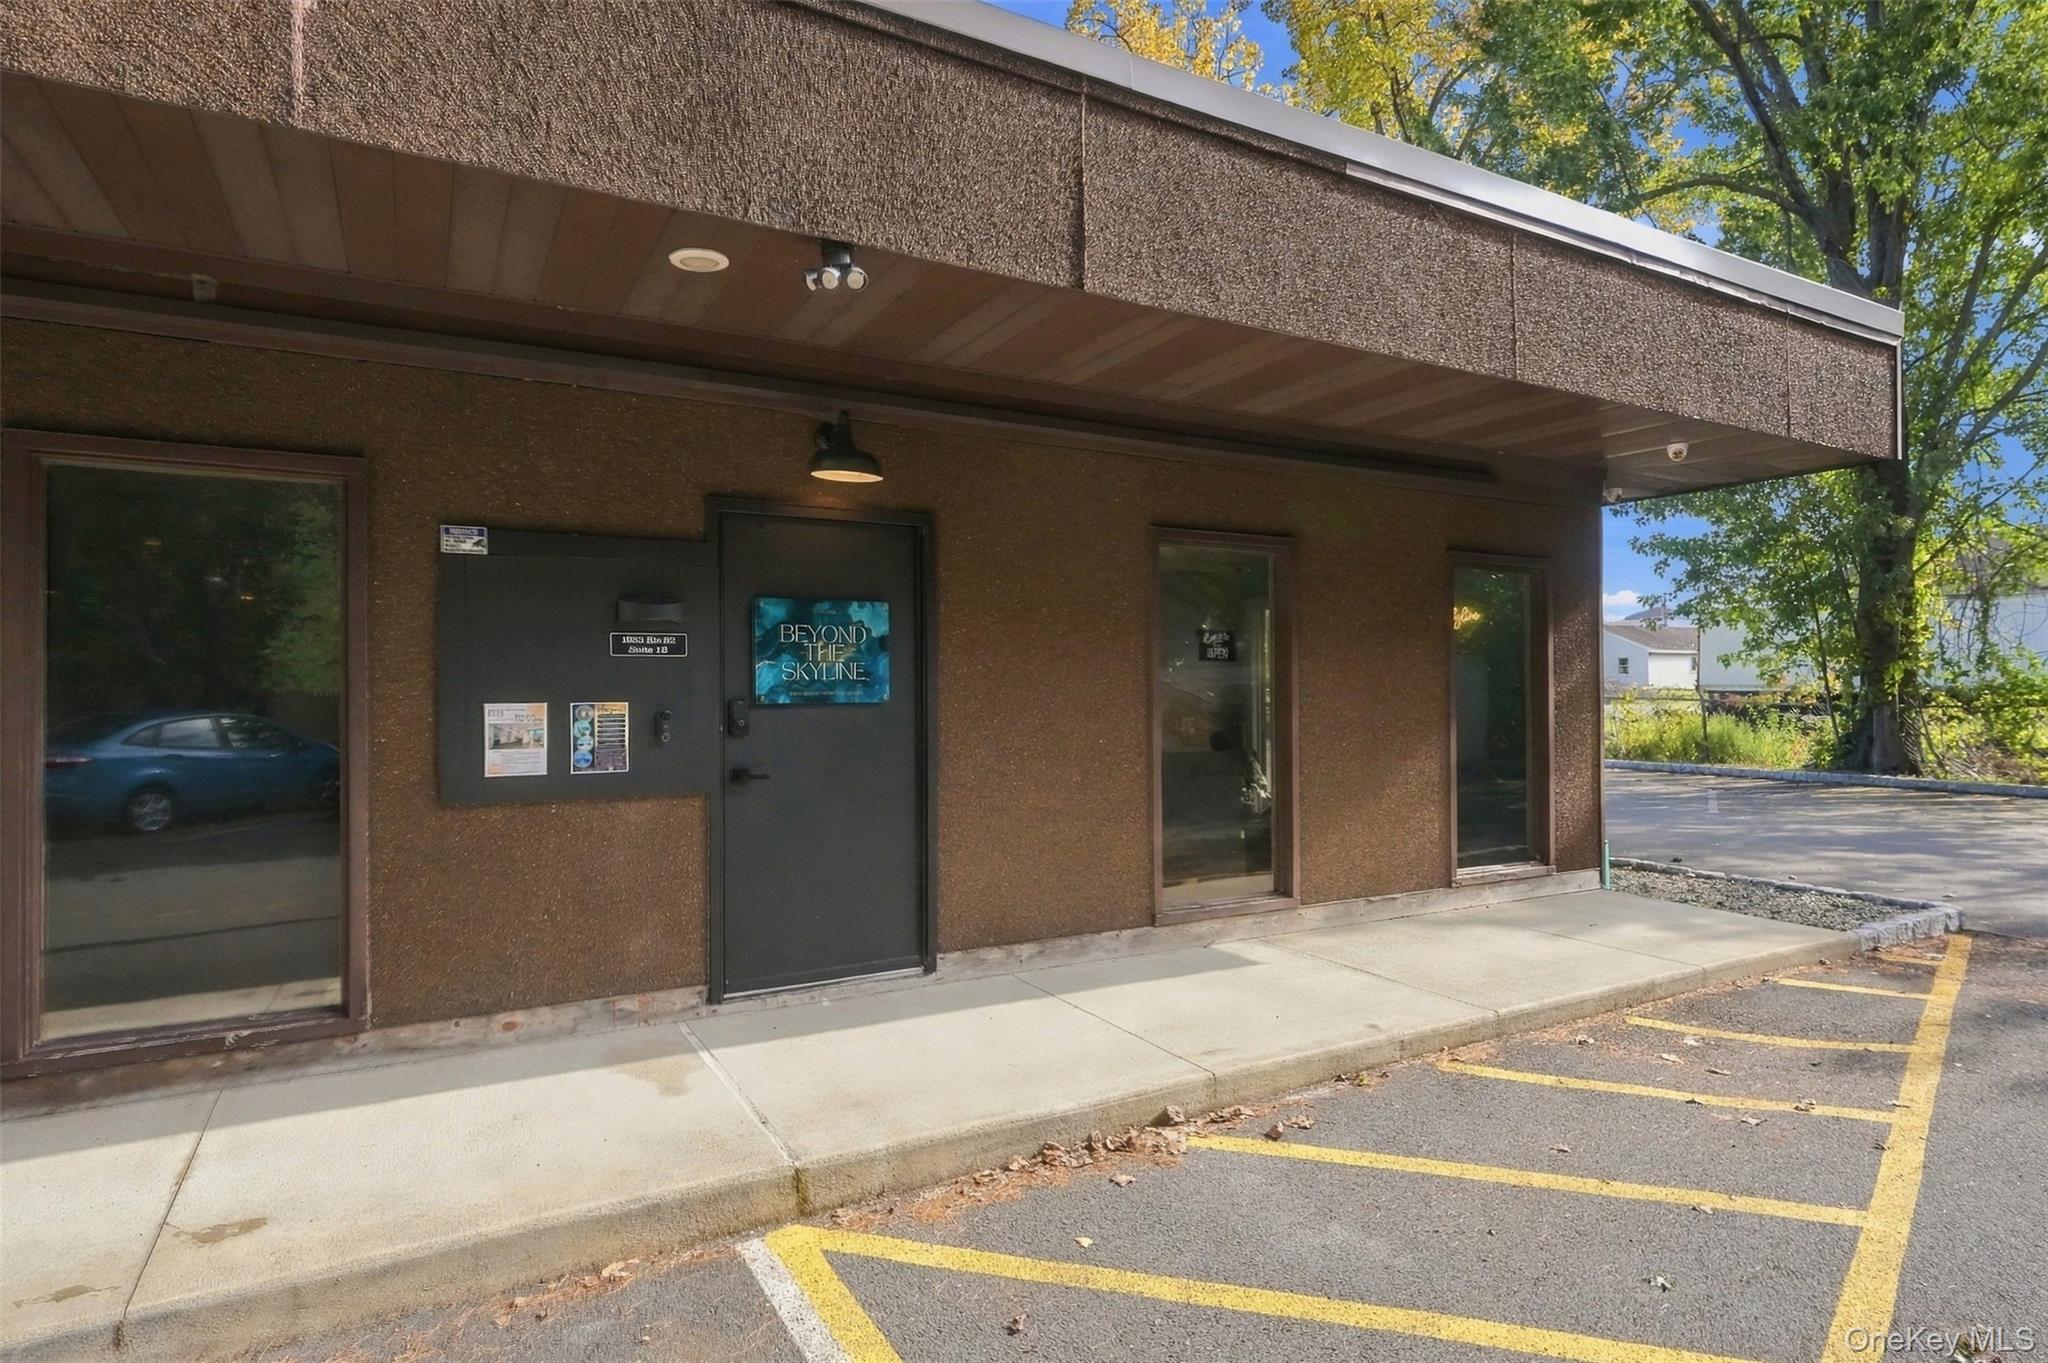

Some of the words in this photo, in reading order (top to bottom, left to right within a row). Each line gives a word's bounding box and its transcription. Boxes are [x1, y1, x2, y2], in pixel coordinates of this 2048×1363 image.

[780, 624, 866, 643] BEYOND
[628, 646, 654, 654] Suite
[656, 646, 668, 654] 1B
[804, 643, 844, 662] THE
[782, 662, 867, 681] SKYLINE
